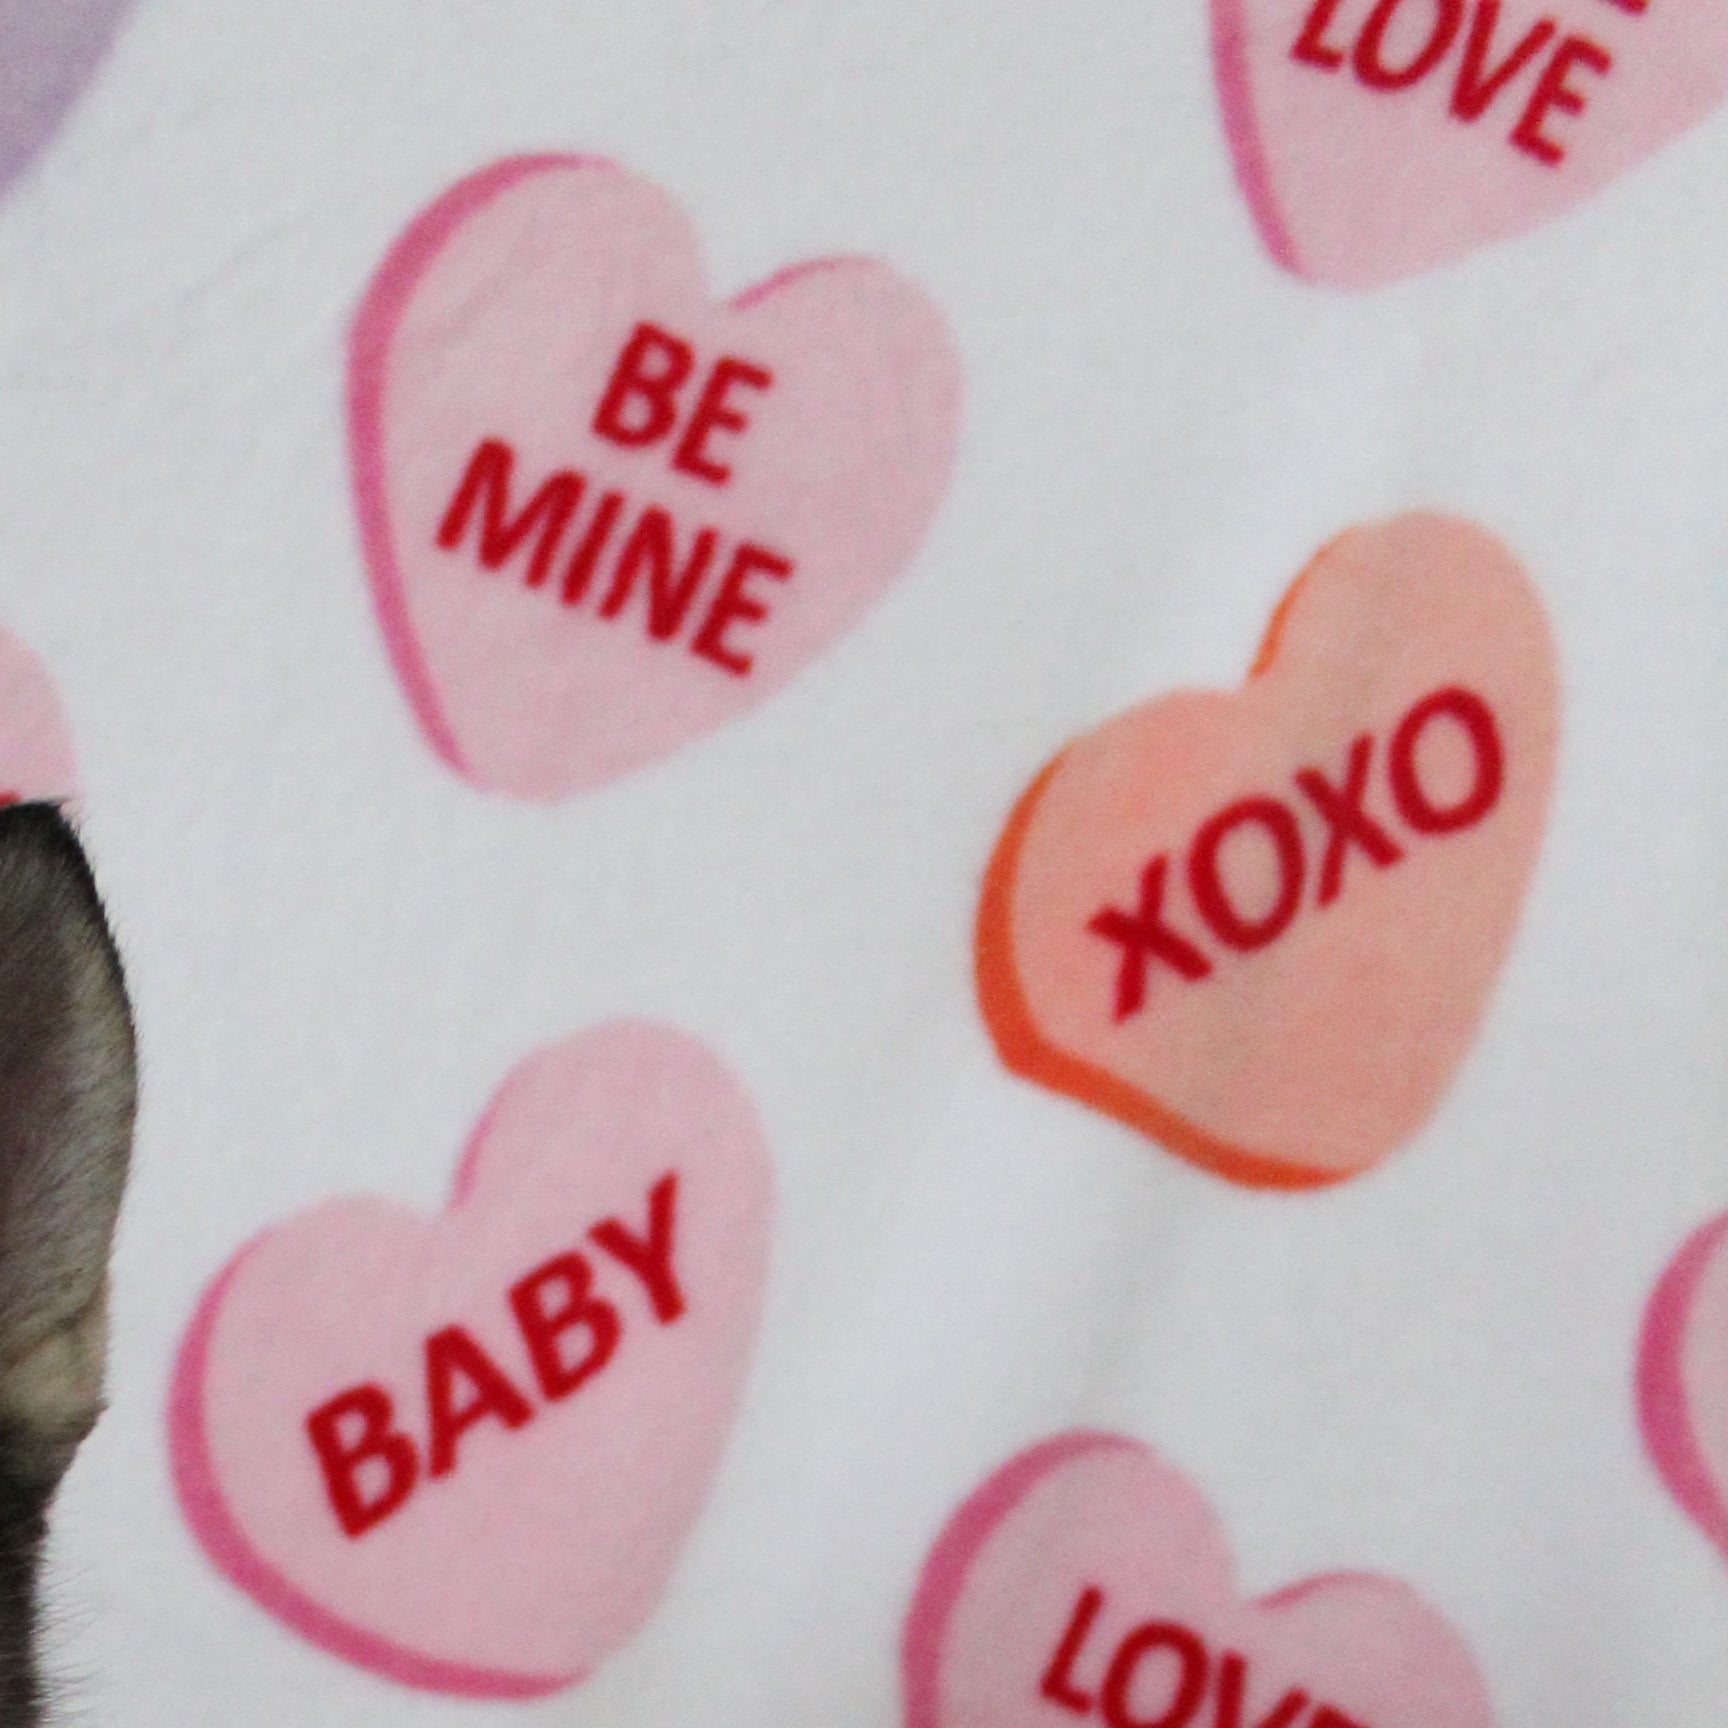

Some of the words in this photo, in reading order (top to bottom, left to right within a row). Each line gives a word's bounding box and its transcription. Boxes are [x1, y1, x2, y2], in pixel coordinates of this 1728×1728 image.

[1289, 0, 1612, 169] LOVE
[590, 321, 774, 488] BE
[434, 436, 795, 678] MINE
[1084, 684, 1505, 1025] XOXO
[304, 1171, 693, 1542] BABY
